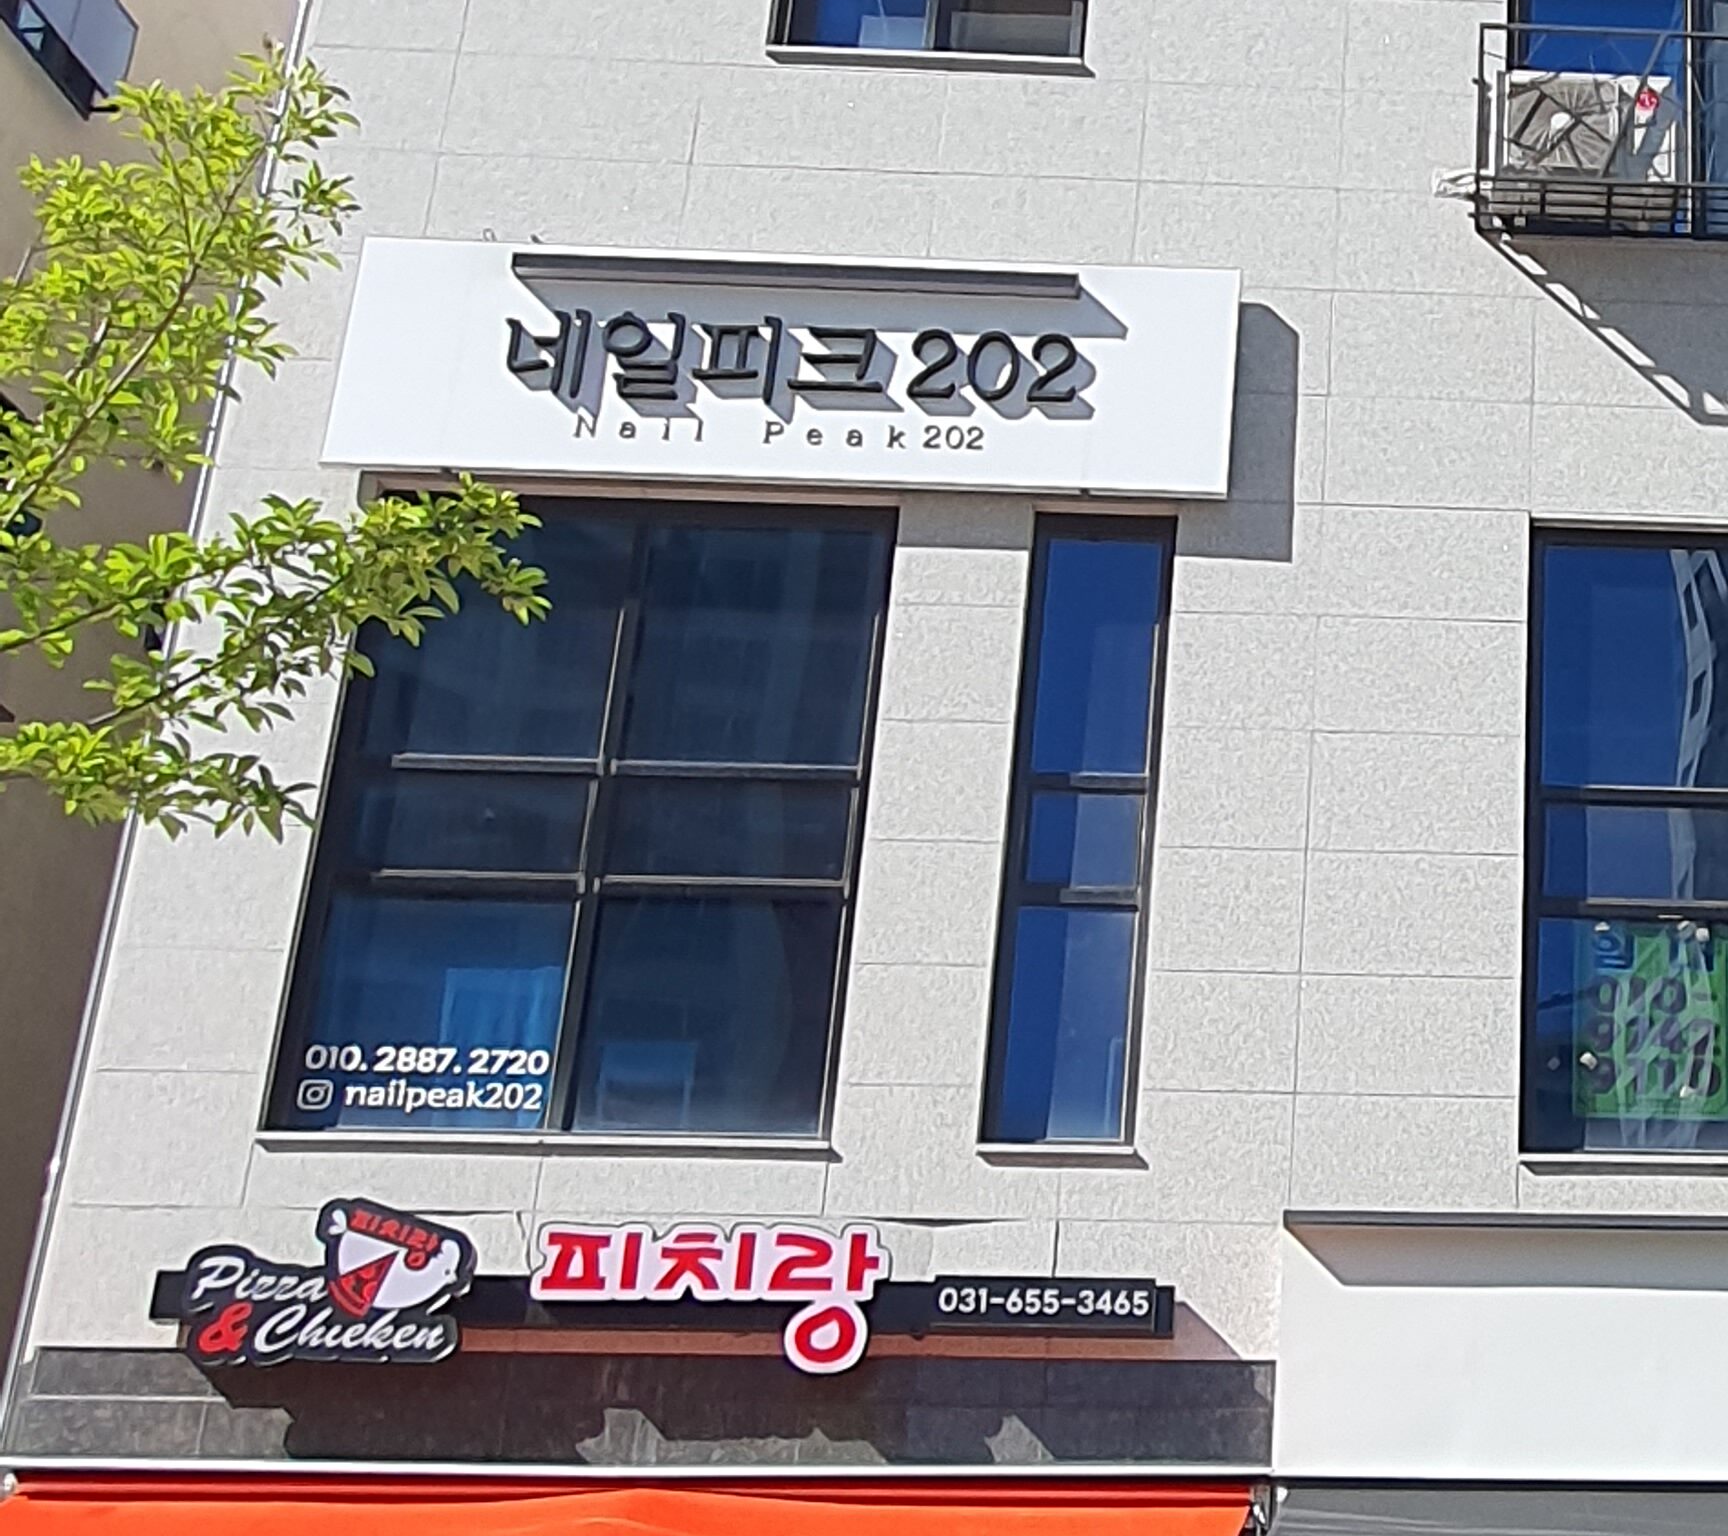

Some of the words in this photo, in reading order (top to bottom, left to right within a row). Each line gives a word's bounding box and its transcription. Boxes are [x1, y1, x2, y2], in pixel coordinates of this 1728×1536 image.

[573, 416, 704, 443] Nail
[345, 1079, 542, 1113] nailpeak202
[191, 1255, 329, 1302] Pizza
[539, 1231, 880, 1364] 피치랑
[938, 1285, 1149, 1317] 031-655-3465
[199, 1304, 252, 1353] &
[254, 1307, 446, 1354] Chicken
